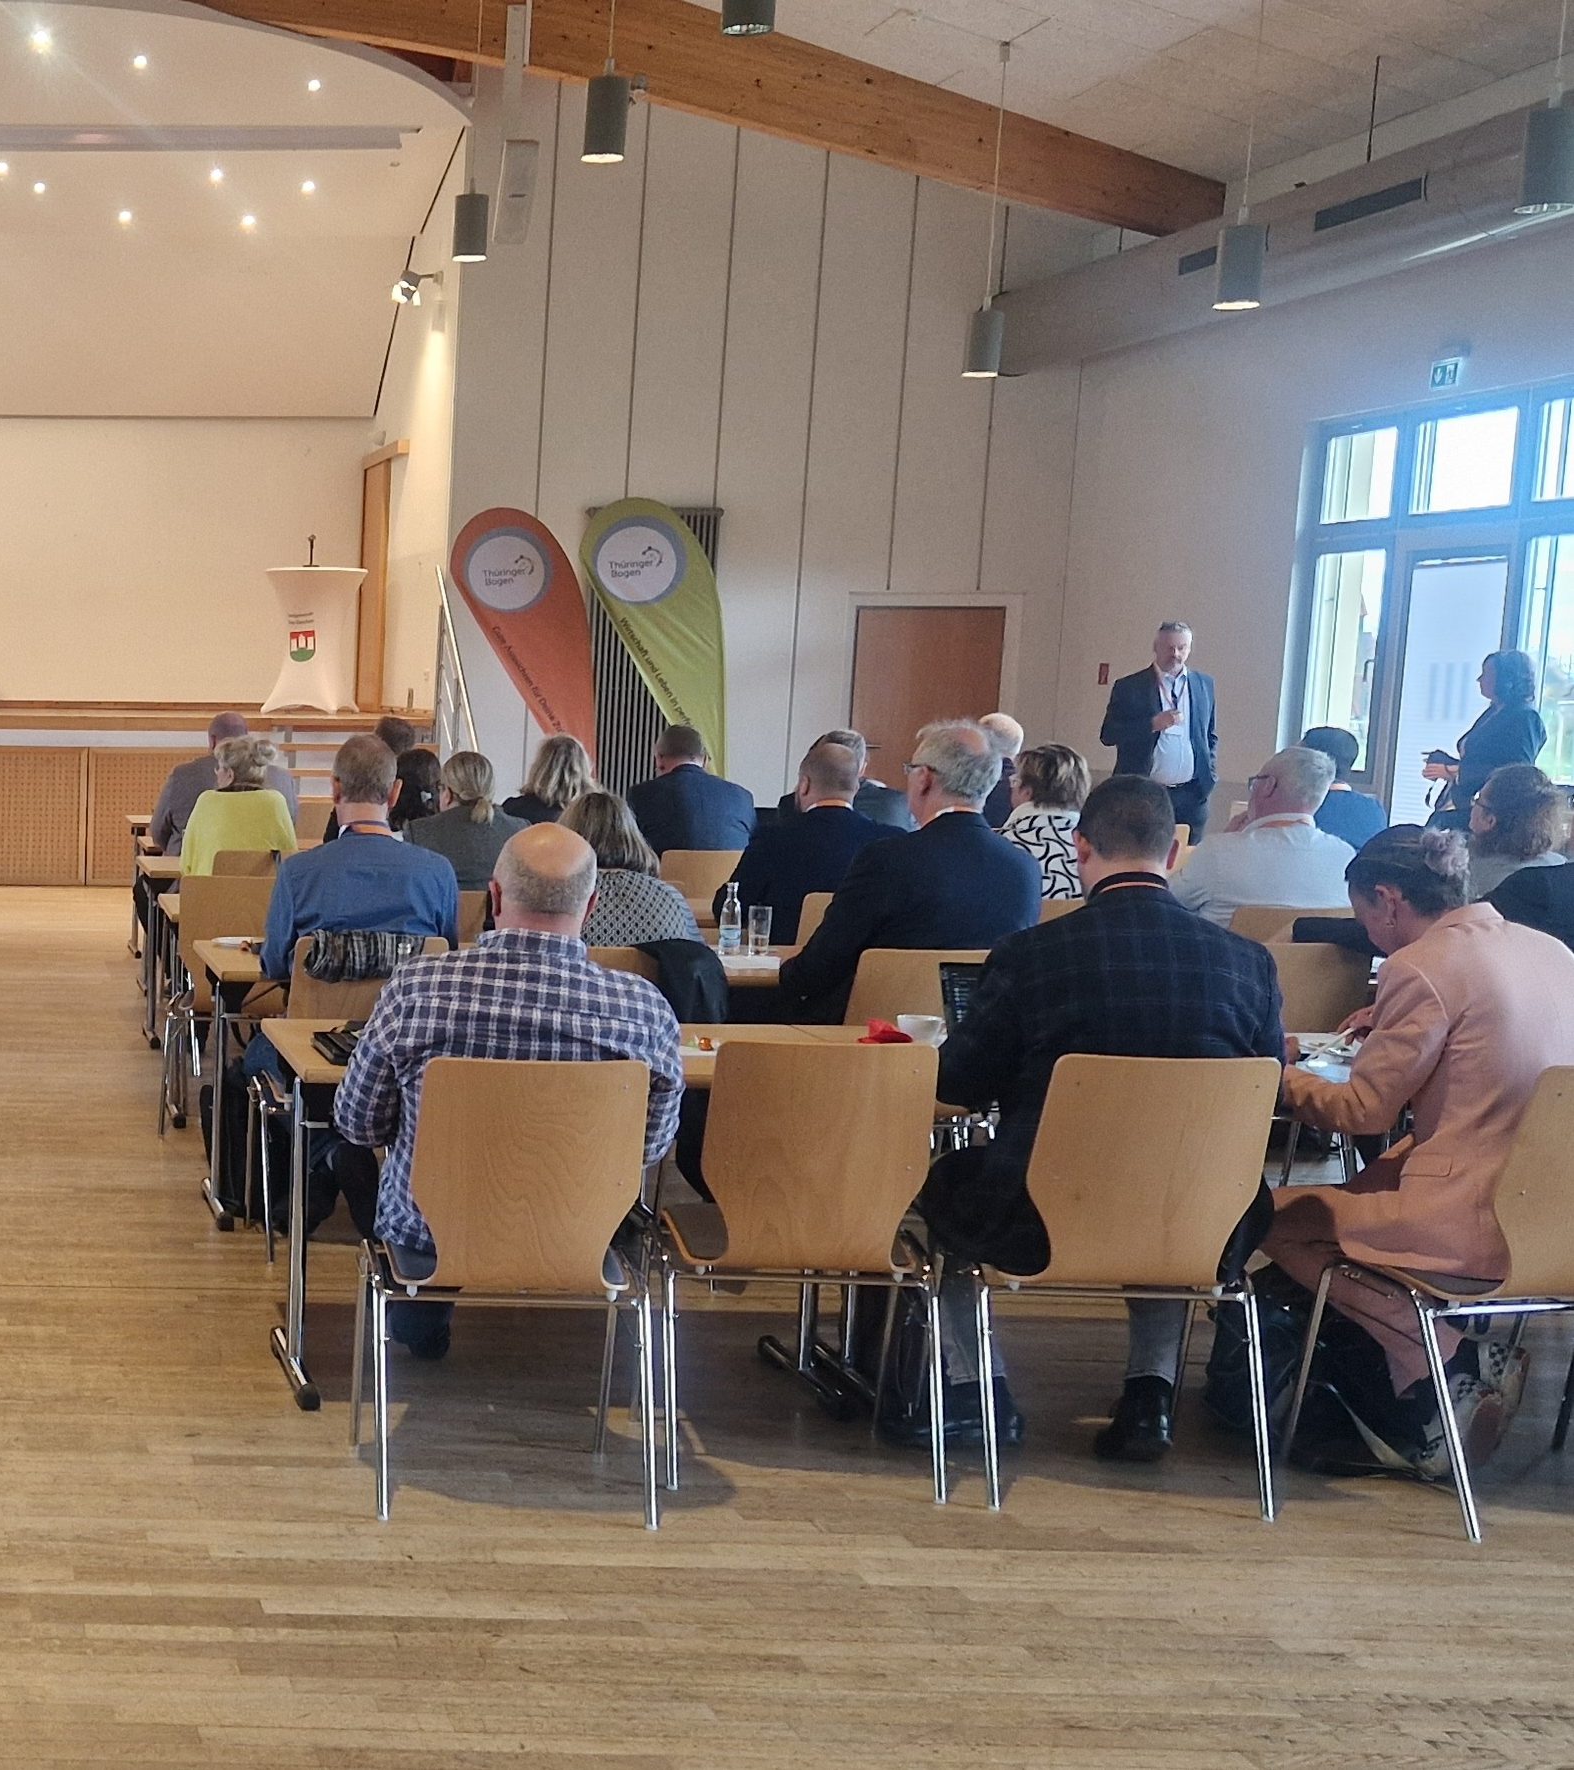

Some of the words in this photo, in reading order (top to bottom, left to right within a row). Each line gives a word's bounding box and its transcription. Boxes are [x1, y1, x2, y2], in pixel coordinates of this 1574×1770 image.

[608, 560, 654, 569] Thüringer
[482, 567, 527, 577] Thüringer
[610, 569, 641, 579] Bogen
[484, 577, 514, 587] Bogen
[620, 617, 649, 658] Wirtschaft
[645, 657, 660, 673] und
[655, 672, 674, 698] Leben
[670, 697, 679, 707] in
